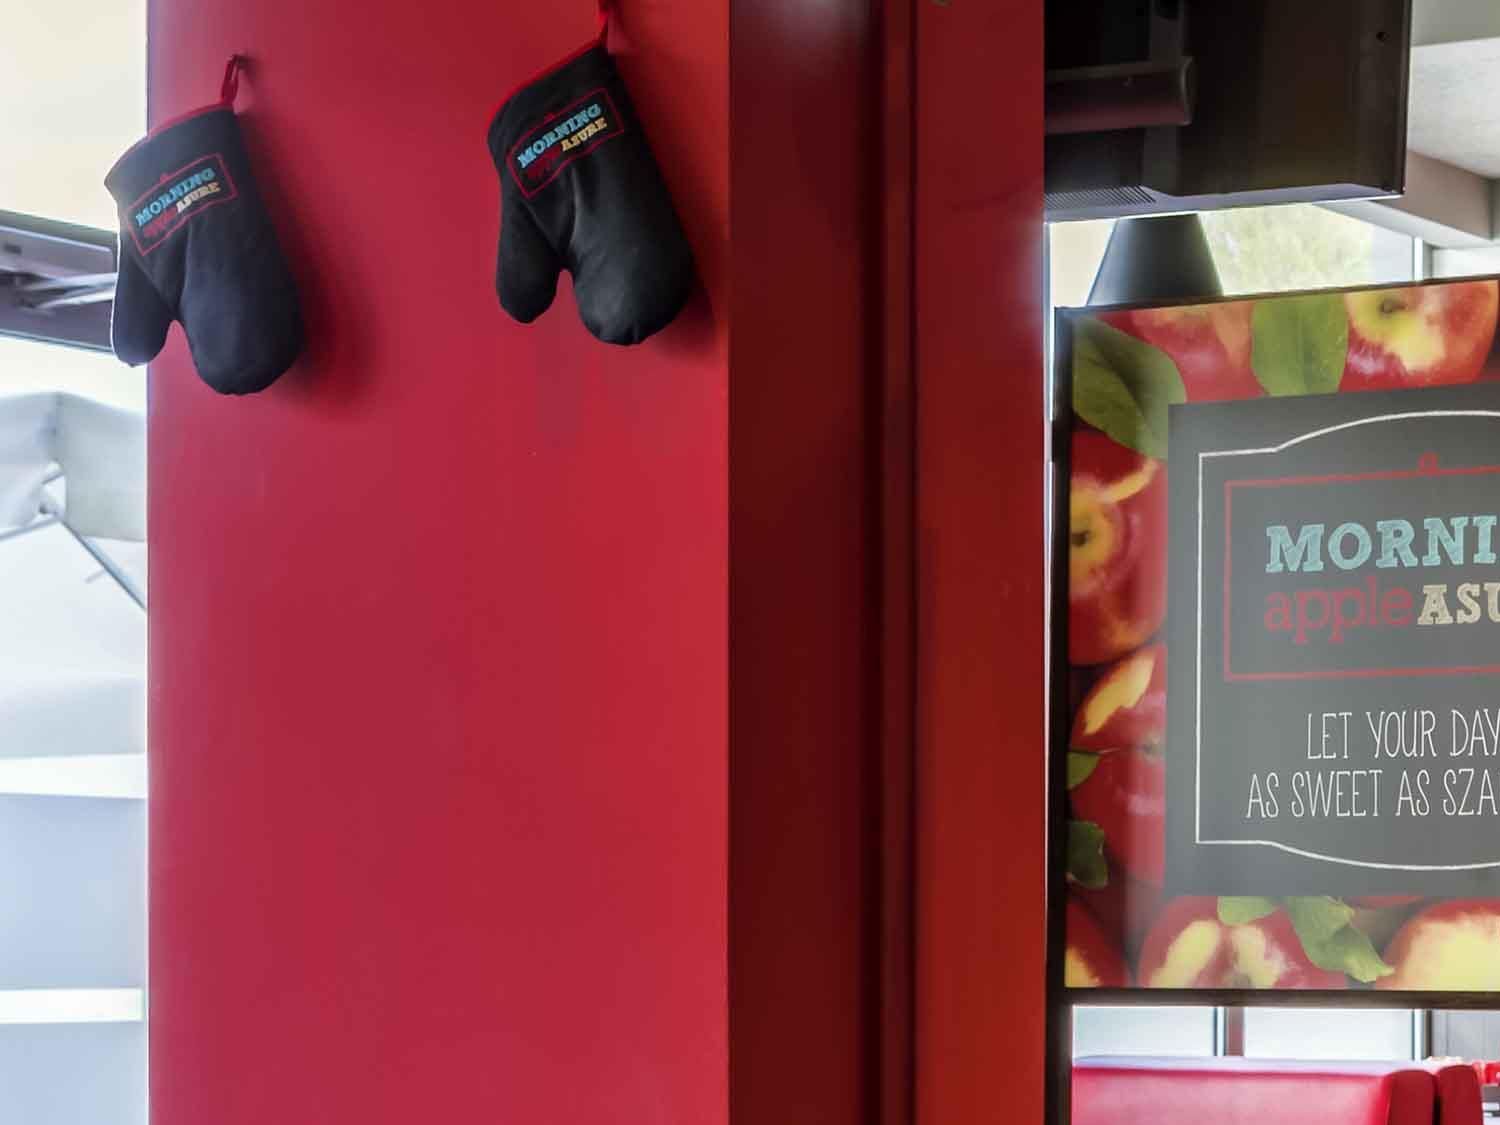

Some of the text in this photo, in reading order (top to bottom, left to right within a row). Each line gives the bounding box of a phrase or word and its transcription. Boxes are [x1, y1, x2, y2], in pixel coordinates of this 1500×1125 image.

[517, 103, 602, 169] MORNING
[135, 167, 217, 227] MORNING
[1307, 711, 1352, 760] LET
[1366, 709, 1437, 759] YOUR
[1246, 771, 1279, 818] AS
[1291, 769, 1382, 816] SWEET
[1395, 768, 1430, 816] AS
